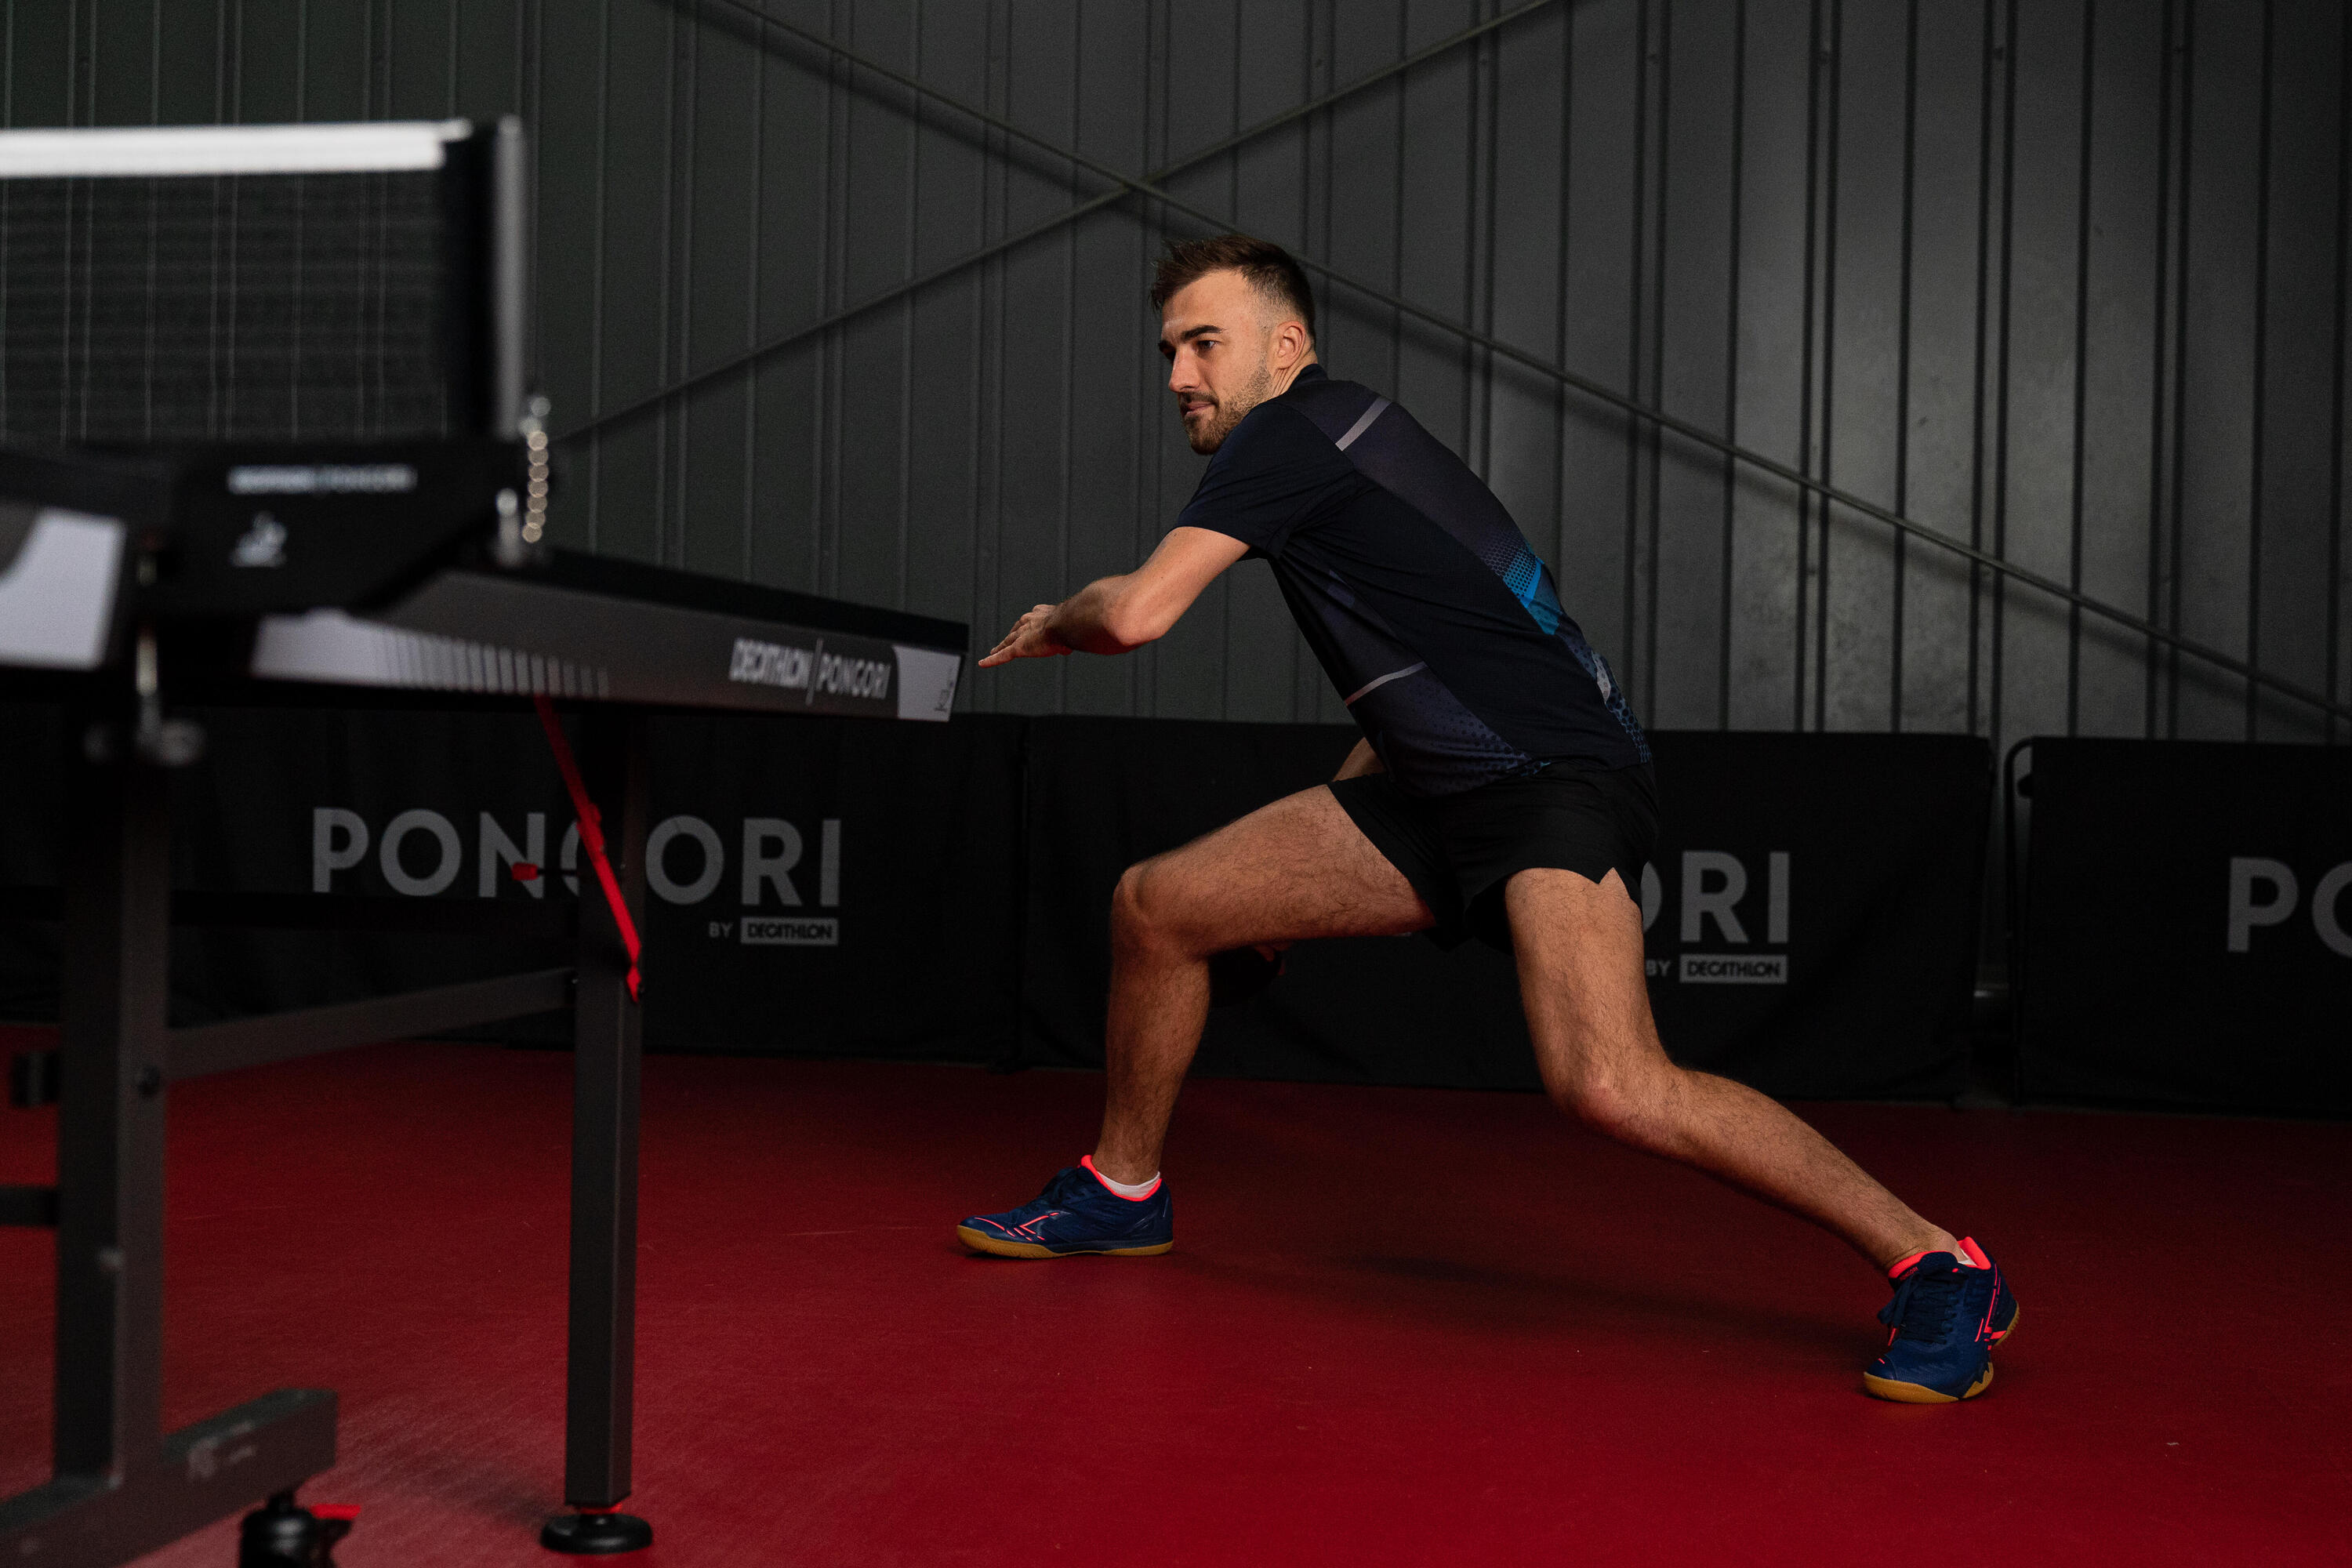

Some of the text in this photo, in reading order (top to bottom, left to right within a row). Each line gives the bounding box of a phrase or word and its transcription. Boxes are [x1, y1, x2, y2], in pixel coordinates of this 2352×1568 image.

[815, 651, 891, 700] PONGORI
[1640, 849, 1791, 944] RI
[708, 921, 833, 939] BY DECATHLON
[1645, 959, 1780, 978] BY DECATHLON
